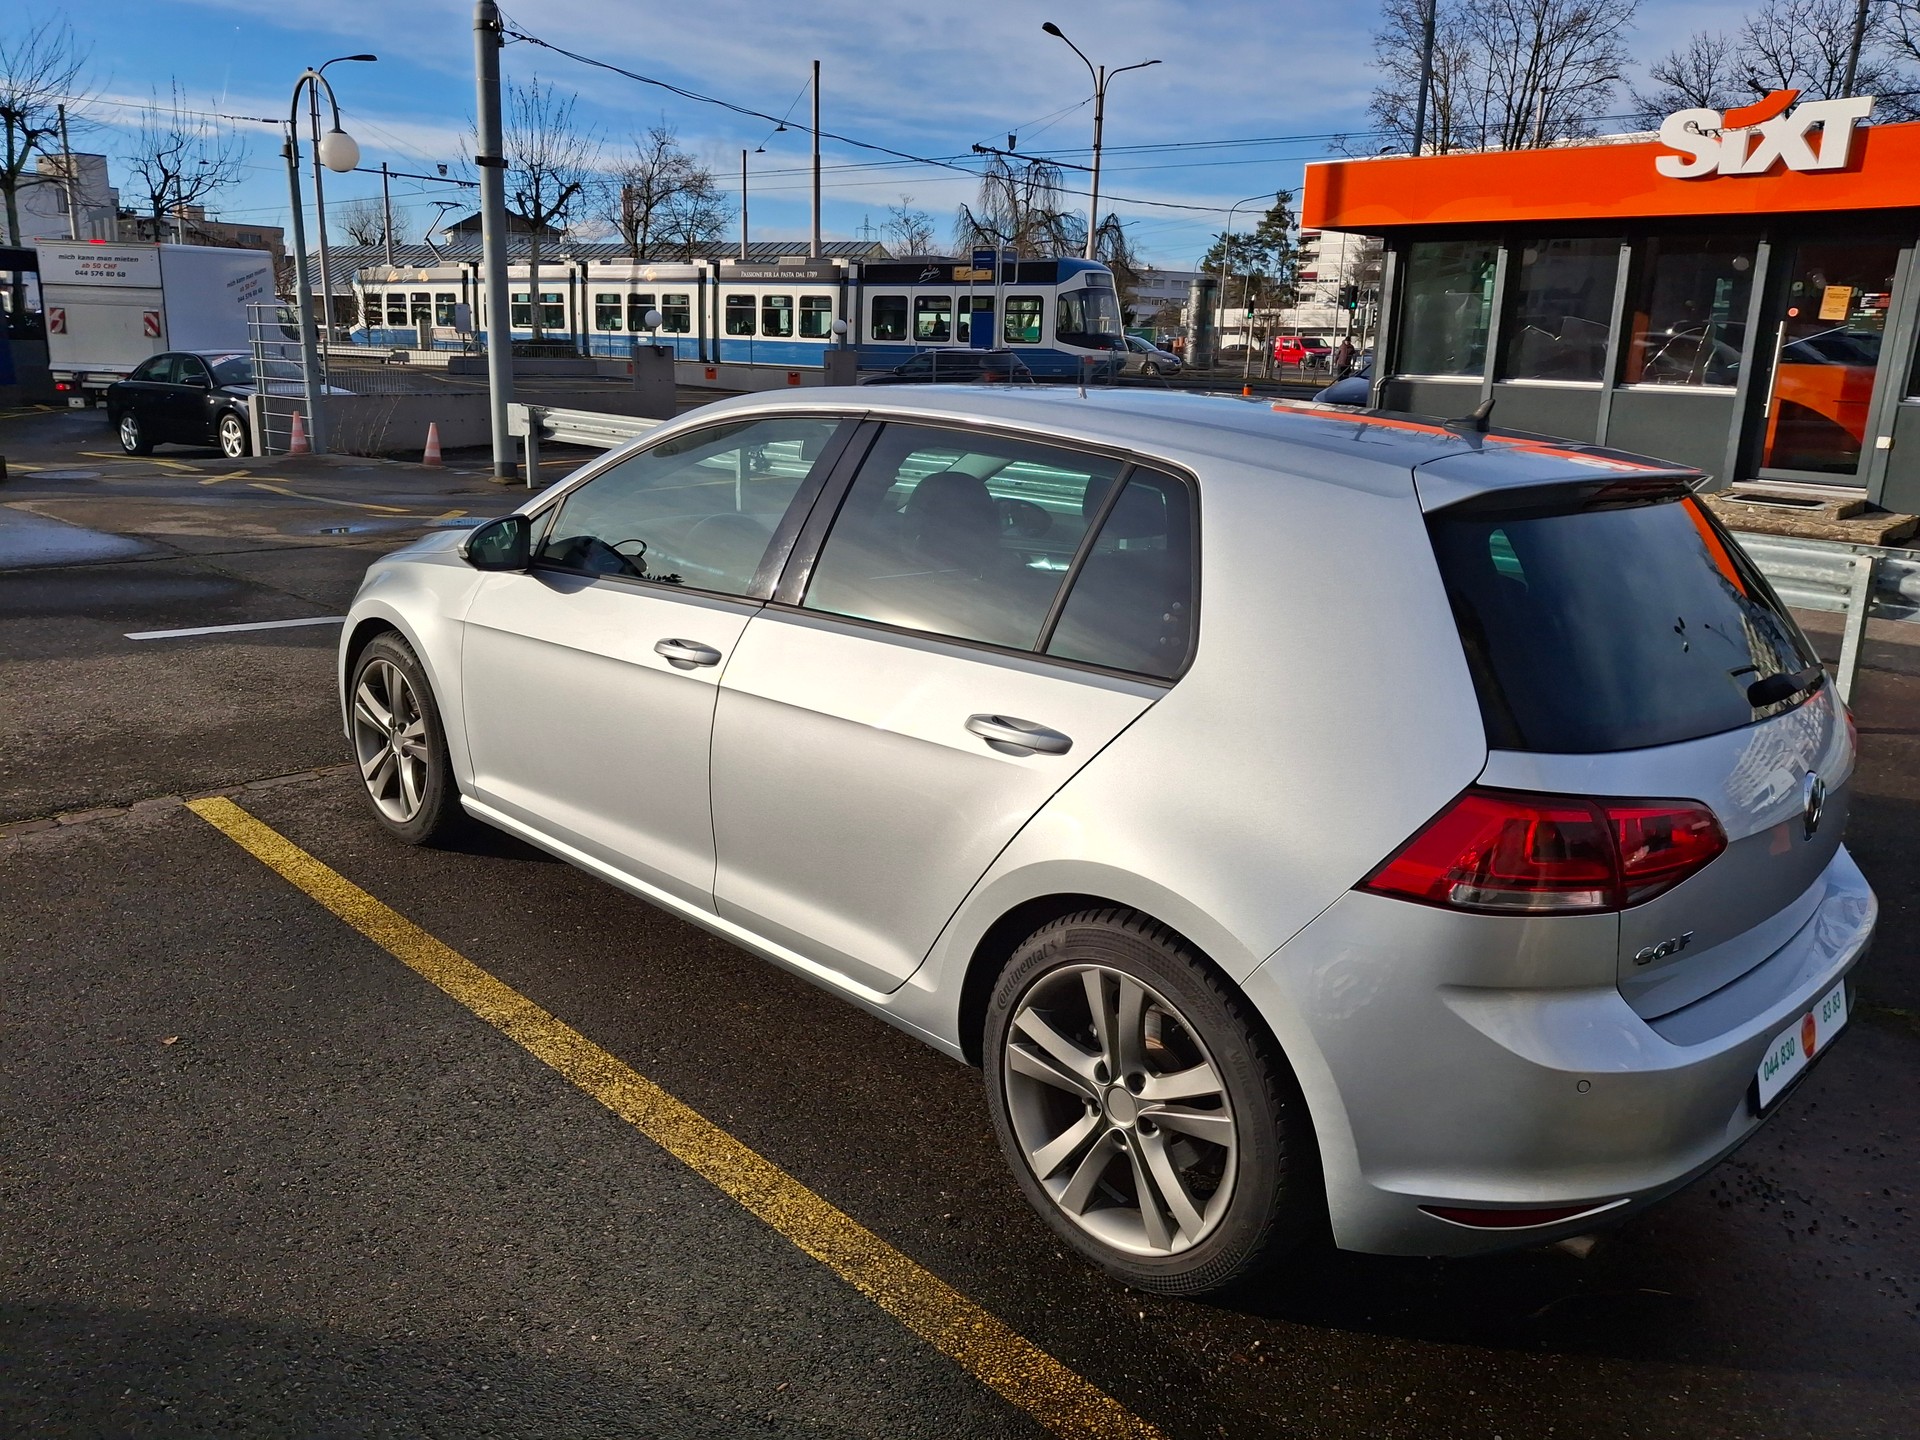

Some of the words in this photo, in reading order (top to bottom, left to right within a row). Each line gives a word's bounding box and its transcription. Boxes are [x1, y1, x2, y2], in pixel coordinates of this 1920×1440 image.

[997, 943, 1048, 1010] Continental
[1633, 930, 1694, 966] GOLF
[1763, 1051, 1779, 1081] 044
[1780, 1037, 1795, 1066] 830
[1822, 1000, 1832, 1023] 83
[1832, 991, 1841, 1013] 83
